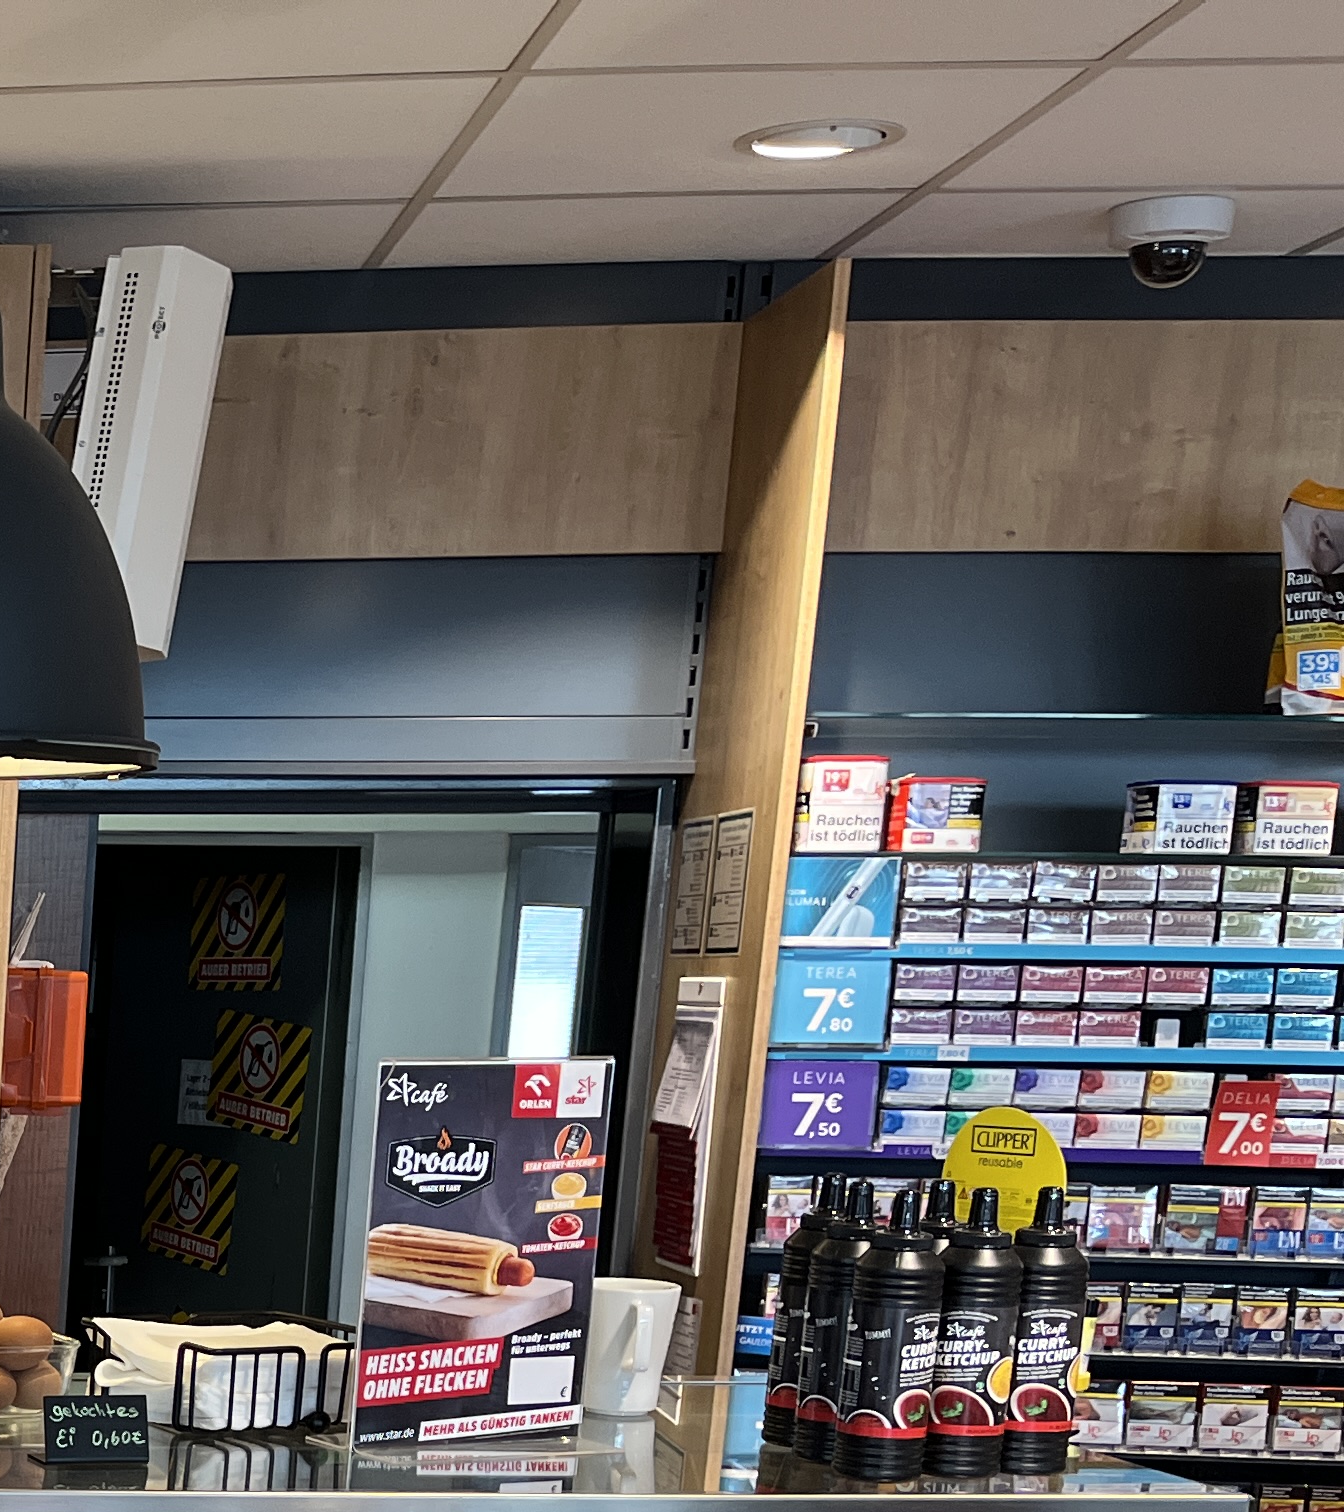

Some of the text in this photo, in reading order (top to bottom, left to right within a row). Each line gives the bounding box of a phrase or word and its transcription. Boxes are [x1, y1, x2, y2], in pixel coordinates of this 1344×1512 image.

[1302, 653, 1329, 672] 39
[816, 813, 880, 827] Rauchen
[1164, 821, 1228, 835] Rauchen
[1263, 821, 1327, 835] Rauchen
[811, 828, 882, 843] ist tödlich
[1281, 836, 1330, 850] tödlich
[231, 964, 267, 976] BETRIEB
[806, 967, 857, 979] TEREA
[793, 1071, 845, 1085] LEVIA
[412, 1083, 448, 1111] café
[519, 1099, 551, 1109] ORLEN
[565, 1095, 587, 1106] star
[1222, 1091, 1271, 1105] DELIA
[249, 1106, 286, 1127] BETRIEB
[976, 1129, 1030, 1150] CLIPPER
[393, 1144, 489, 1179] Broady
[978, 1157, 1023, 1169] reusable
[181, 1235, 215, 1258] BETRIEB
[962, 1326, 985, 1339] café
[936, 1339, 989, 1353] CURRY-
[1018, 1337, 1070, 1351] CURRY-
[366, 1344, 499, 1376] HEISS SNACKEN
[935, 1351, 1000, 1366] KETCHUP
[1017, 1347, 1077, 1364] KETCHUP
[363, 1369, 489, 1400] OHNE FLECKEN
[49, 1403, 139, 1422] gekochtes
[423, 1410, 574, 1436] MEHR ALS GÜNSTIG TANKEN!
[56, 1427, 75, 1446] Ei
[360, 1428, 414, 1442] www.star.de
